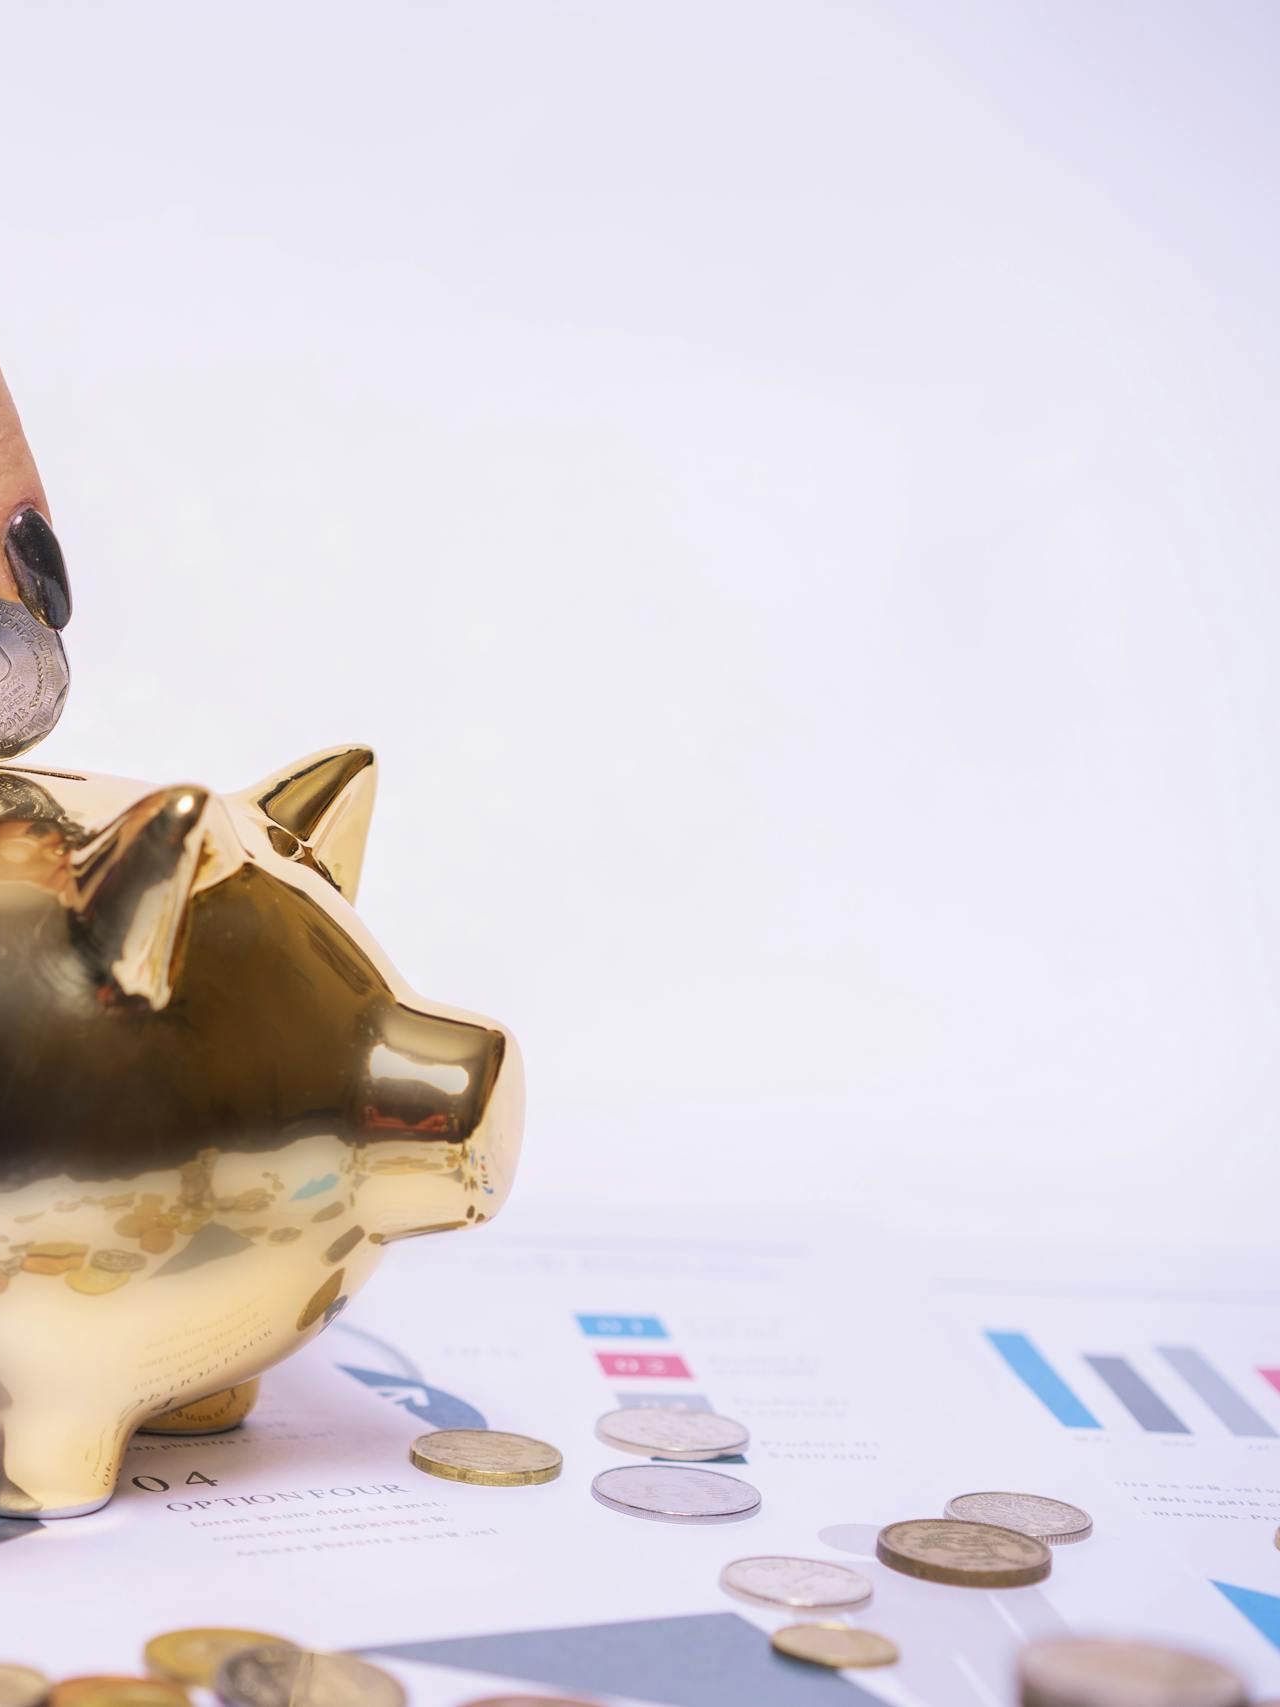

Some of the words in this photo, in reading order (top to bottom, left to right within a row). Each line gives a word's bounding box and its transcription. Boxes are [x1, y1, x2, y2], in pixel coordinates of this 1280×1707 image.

[166, 1491, 304, 1513] OPTION
[307, 1482, 413, 1500] FOUR
[190, 1517, 250, 1529] Lorem
[255, 1511, 311, 1523] ipsum
[316, 1505, 362, 1517] dolor
